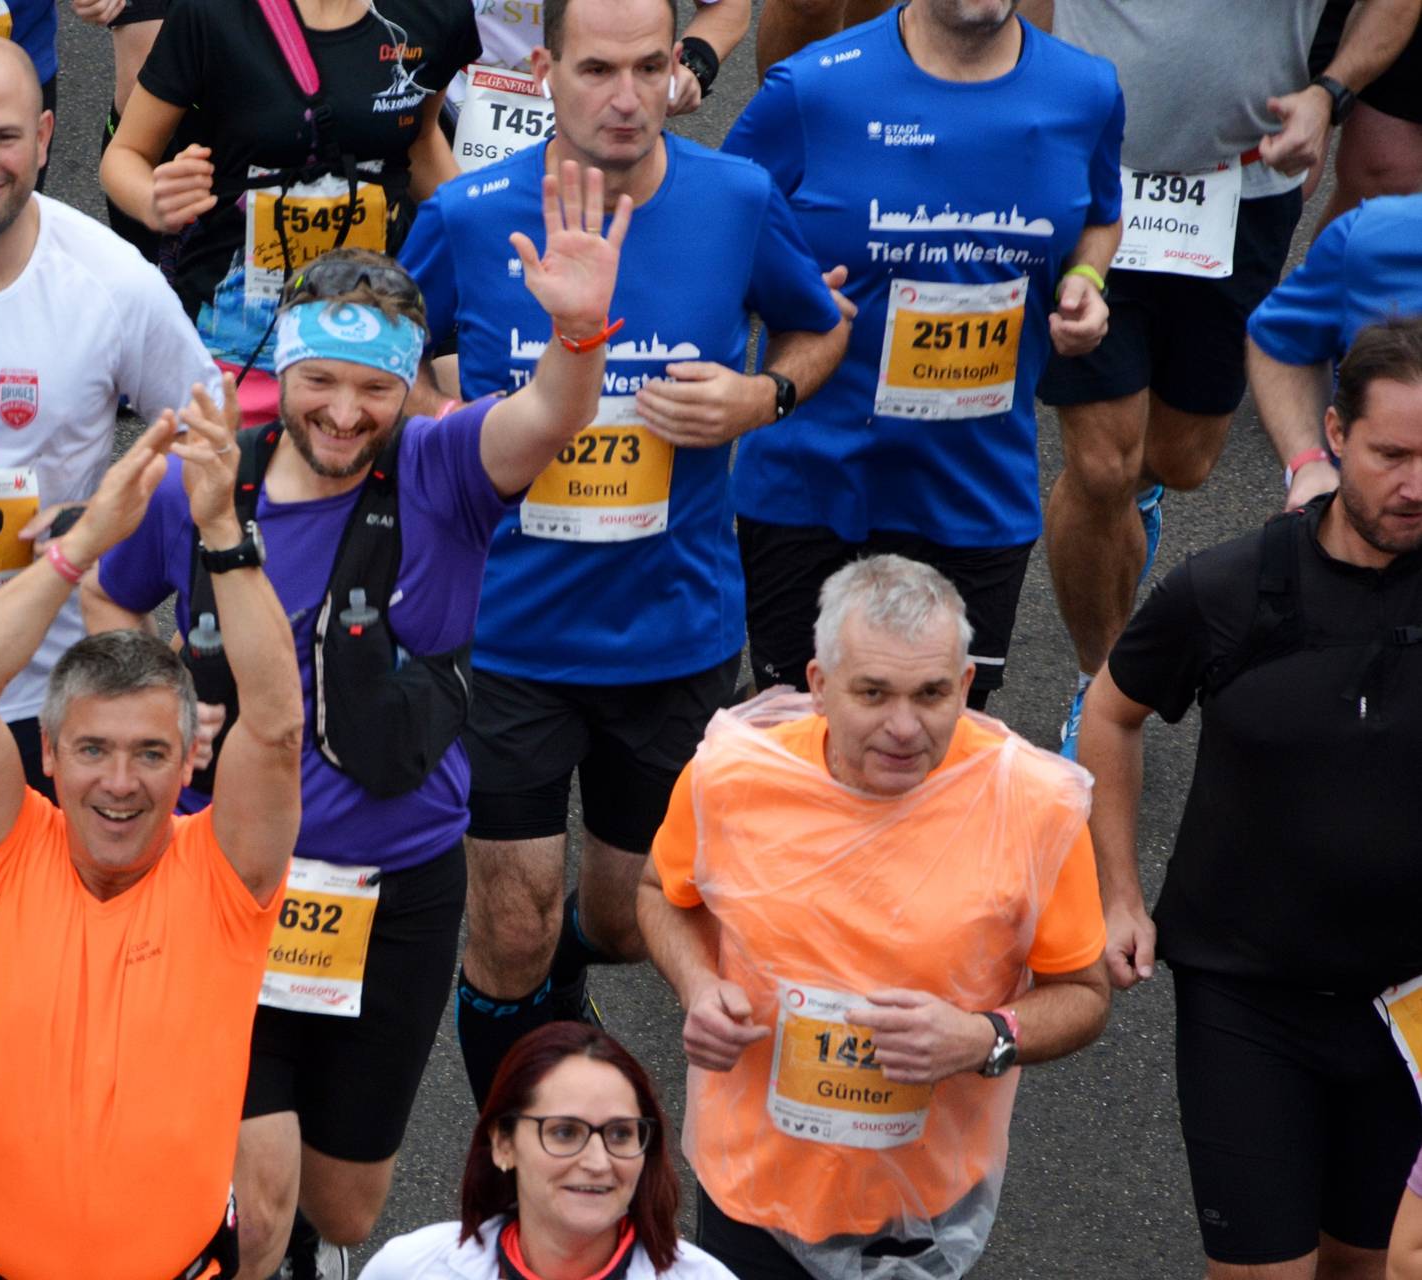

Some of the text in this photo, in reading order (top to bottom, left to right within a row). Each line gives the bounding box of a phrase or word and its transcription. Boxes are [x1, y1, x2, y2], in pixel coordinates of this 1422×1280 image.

[834, 47, 862, 64] JAKO
[487, 75, 540, 96] GENERAL
[884, 124, 920, 135] STADT
[884, 133, 936, 147] BOCHUM
[462, 142, 498, 159] BSG
[481, 176, 511, 196] JAKO
[1131, 171, 1207, 207] T394
[1127, 215, 1201, 237] All4One
[866, 240, 1046, 266] Tief im Westen...
[1163, 247, 1213, 263] saucony
[911, 317, 1010, 351] 25114
[912, 361, 1000, 383] Christoph
[568, 479, 629, 498] Bernd
[277, 898, 344, 935] 632
[267, 944, 334, 969] rédéric
[814, 1030, 883, 1071] 142
[816, 1078, 895, 1106] Günter
[851, 1119, 909, 1133] saucony
